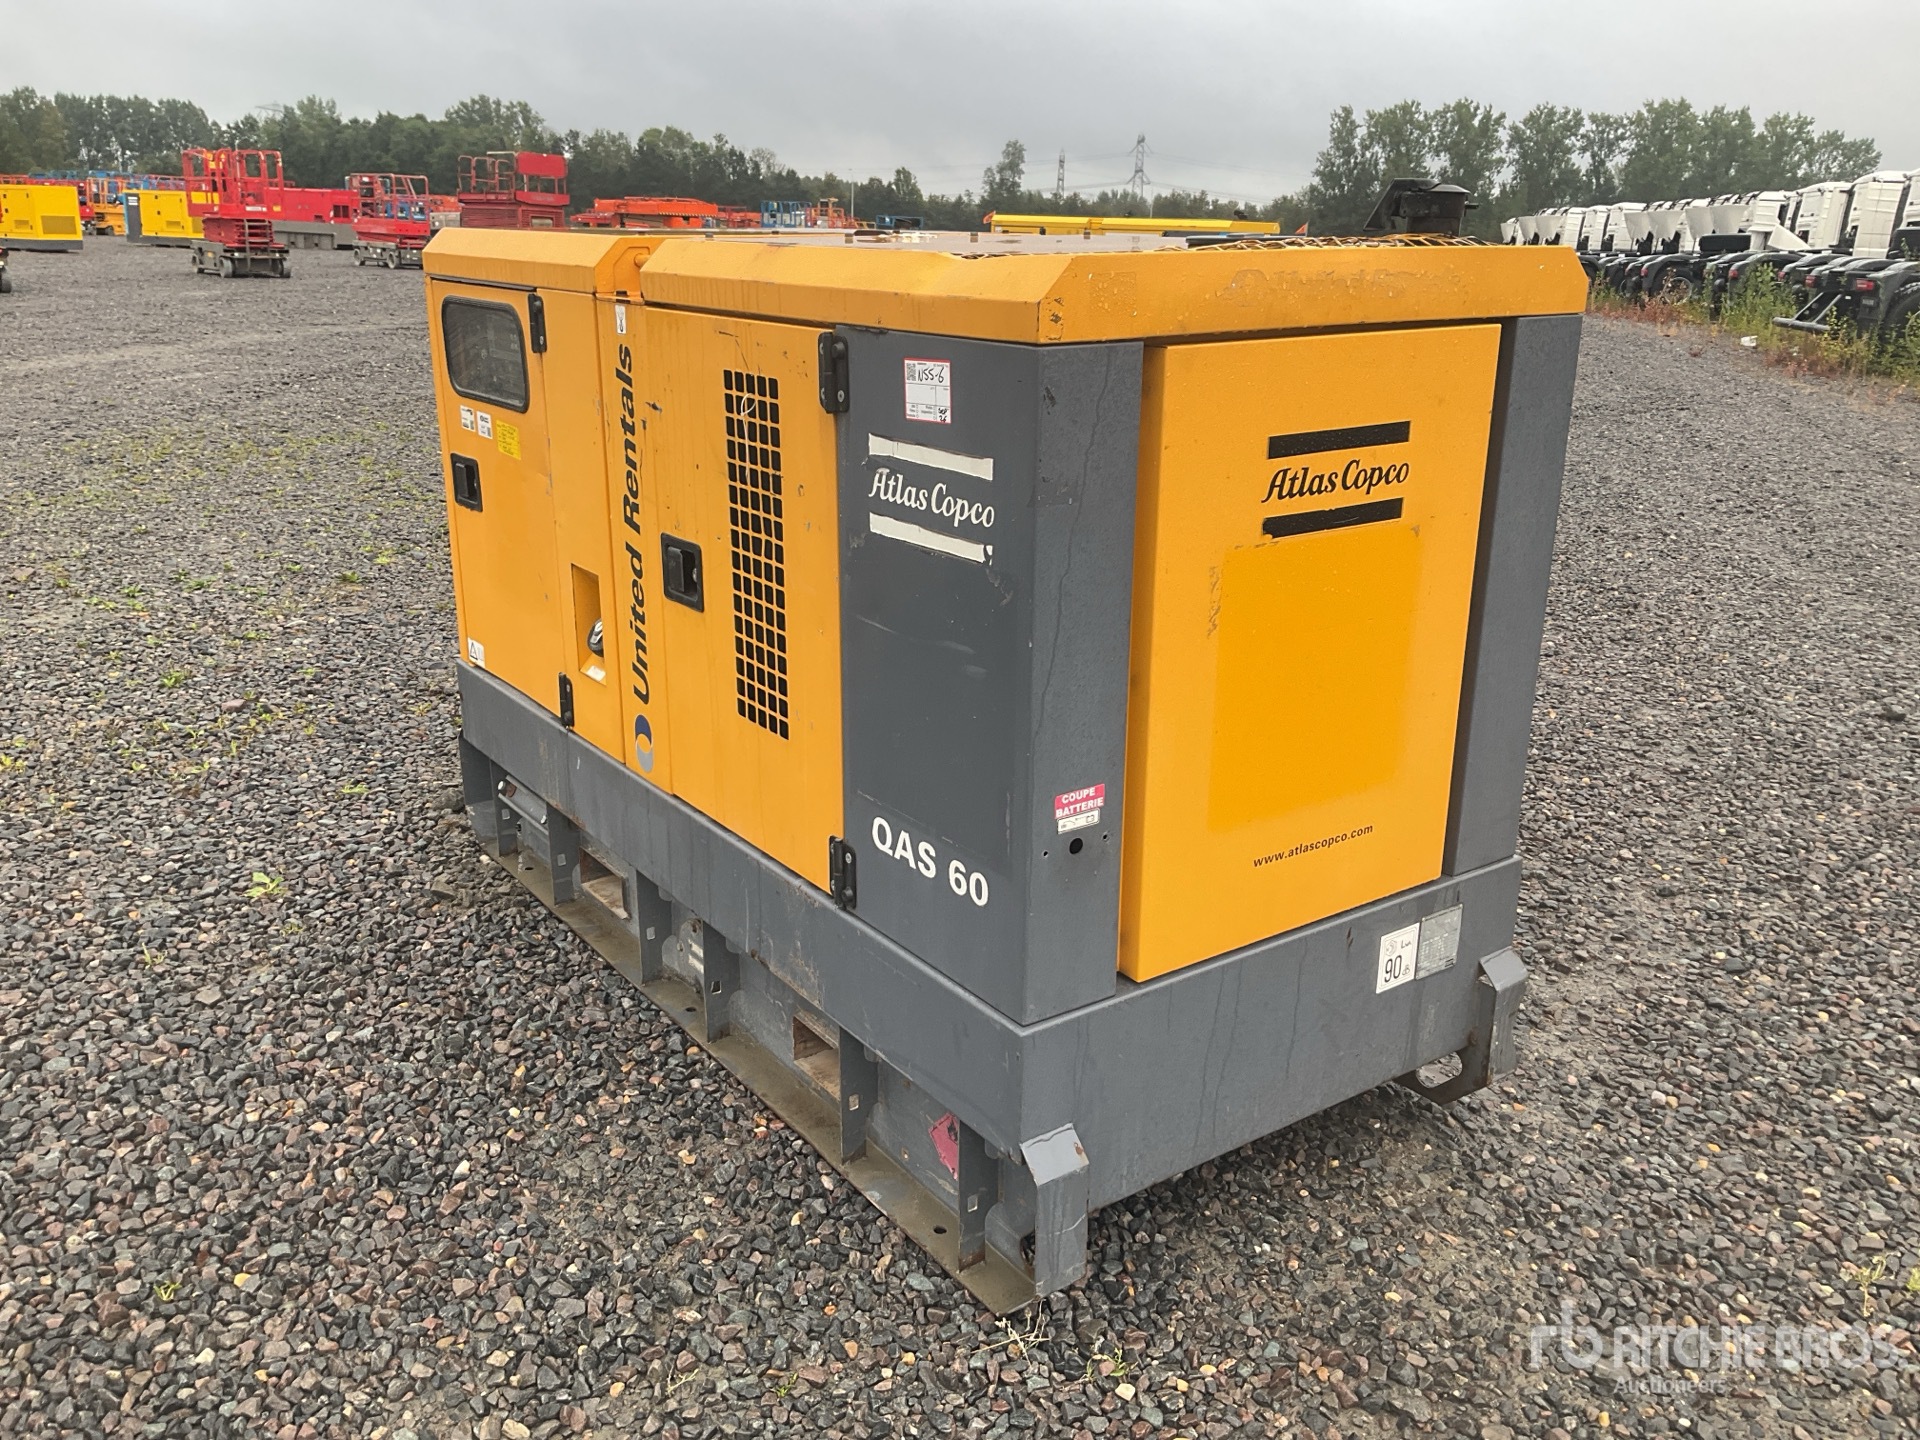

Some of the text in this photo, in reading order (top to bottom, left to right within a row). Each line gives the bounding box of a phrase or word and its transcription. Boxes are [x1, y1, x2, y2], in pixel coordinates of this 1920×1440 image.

[868, 467, 995, 528] Atlas Copco
[1260, 458, 1410, 504] Atlas Copco
[615, 343, 650, 705] United Rentals
[1055, 796, 1104, 819] BATTERIE
[1061, 786, 1096, 804] COUPE
[871, 816, 989, 907] QAS 60
[1253, 825, 1374, 867] www.atlascopco.com
[1384, 954, 1403, 983] 90
